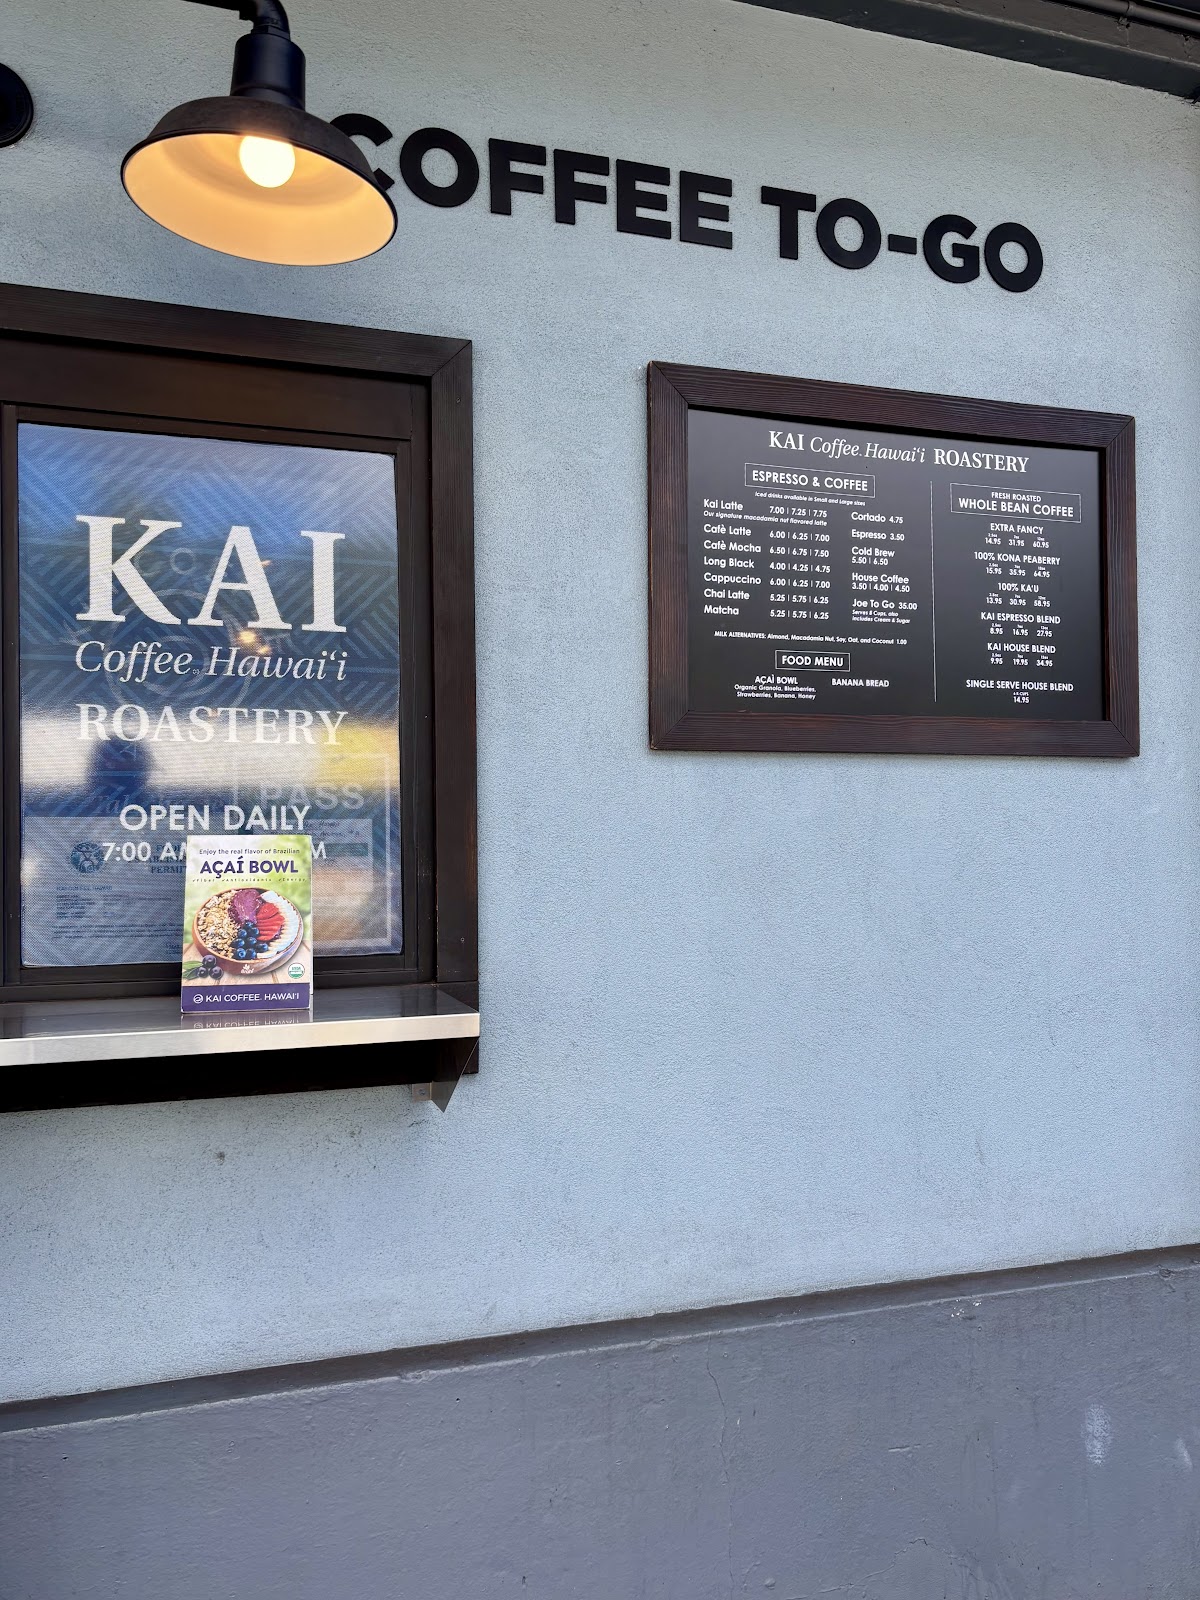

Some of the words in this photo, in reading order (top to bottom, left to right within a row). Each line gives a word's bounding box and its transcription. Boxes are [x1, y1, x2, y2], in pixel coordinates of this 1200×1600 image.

[329, 113, 733, 250] COFFEE
[761, 186, 1043, 293] TO-GO
[769, 430, 805, 450] KAI
[810, 436, 860, 458] Coffee
[934, 448, 1030, 472] ROASTERY
[752, 470, 809, 486] ESPRESSO
[812, 476, 821, 487] &
[824, 477, 868, 492] COFFEE
[991, 492, 1011, 500] FRESH
[1012, 494, 1042, 502] ROASTED
[704, 498, 718, 508] Kai
[720, 500, 744, 511] Latte
[958, 498, 998, 512] WHOLE
[1000, 501, 1030, 514] BEAN
[1033, 504, 1074, 518] COFFEE
[769, 506, 785, 514] 7.00
[792, 508, 806, 516] 7.25
[812, 509, 828, 518] 7.75
[851, 512, 886, 522] Cortado
[888, 516, 904, 524] 4.75
[716, 511, 742, 520] signature
[744, 514, 778, 522] macadamia
[790, 518, 814, 526] flavored
[729, 526, 752, 536] Latte
[990, 522, 1015, 532] EXTRA
[1016, 524, 1044, 534] FANCY
[769, 530, 786, 539] 6.00
[792, 532, 808, 540] 6.25
[814, 534, 830, 542] 7.00
[851, 528, 887, 540] Espresso
[890, 533, 905, 542] 3.50
[728, 541, 762, 553] Mocha
[985, 537, 1002, 545] 14.95
[1008, 539, 1025, 547] 31.95
[1032, 541, 1050, 549] 60.95
[769, 546, 786, 555] 6.50
[792, 548, 808, 556] 6.75
[814, 549, 830, 558] 7.50
[851, 546, 873, 556] Cold
[874, 548, 895, 558] Brew
[704, 556, 727, 568] Long
[728, 558, 755, 568] Black
[852, 556, 867, 564] 5.50
[873, 558, 889, 566] 6.50
[974, 552, 996, 561] 100%
[998, 554, 1022, 563] KONA
[1023, 555, 1061, 566] PEABERRY
[76, 514, 346, 633] KAI
[769, 562, 786, 570] 4.00
[792, 563, 809, 572] 4.25
[814, 565, 831, 574] 4.75
[986, 567, 1002, 575] 15.95
[1009, 568, 1026, 576] 35.95
[1034, 570, 1050, 578] 64.95
[704, 572, 762, 584] Cappuccino
[769, 578, 786, 586] 6.00
[792, 579, 809, 588] 6.25
[815, 580, 831, 589] 7.00
[852, 572, 879, 582] House
[880, 574, 910, 584] Coffee
[852, 582, 868, 590] 3.50
[873, 583, 889, 592] 4.00
[894, 585, 910, 593] 4.50
[998, 582, 1019, 592] 100%
[704, 588, 726, 598] Chai
[728, 590, 750, 600] Latte
[769, 594, 786, 602] 5.25
[792, 594, 808, 604] 5.75
[813, 596, 829, 604] 6.25
[852, 598, 868, 608] Joe
[870, 599, 880, 608] To
[882, 600, 896, 609] Go
[898, 602, 918, 610] 35.00
[986, 596, 1002, 605] 13.95
[1009, 598, 1026, 606] 30.95
[704, 604, 740, 615] Matcha
[769, 609, 786, 618] 5.25
[792, 610, 808, 620] 5.75
[813, 612, 830, 620] 6.25
[980, 612, 995, 621] KAI
[997, 612, 1035, 623] ESPRESSO
[1036, 614, 1061, 624] BLEND
[714, 630, 728, 638] MILK
[728, 631, 767, 640] ALTERNATIVES:
[790, 634, 824, 642] Macadamia
[1012, 628, 1029, 636] 16.95
[1036, 630, 1053, 638] 27.95
[987, 642, 1002, 651] KAI
[1003, 644, 1030, 653] HOUSE
[1032, 644, 1056, 654] BLEND
[76, 640, 193, 682] Coffee
[782, 654, 812, 666] FOOD
[814, 656, 844, 667] MENU
[1012, 658, 1029, 666] 19.95
[776, 676, 799, 684] BOWL
[831, 678, 864, 687] BANANA
[866, 679, 890, 688] BREAD
[966, 679, 995, 690] SINGLE
[996, 680, 1020, 690] SERVE
[1022, 682, 1048, 691] HOUSE
[1050, 682, 1074, 692] BLEND
[734, 684, 758, 692] Organic
[1013, 696, 1030, 704] 14.95
[76, 704, 348, 746] ROASTERY
[259, 783, 366, 810] PASS
[119, 804, 210, 831] OPEN
[224, 804, 311, 831] DAILY
[102, 842, 151, 862] 7:00
[311, 840, 327, 860] M
[199, 848, 217, 856] Enjoy
[200, 856, 244, 878] AÇAÍ
[249, 860, 299, 874] BOWL
[205, 994, 222, 1002] KAI
[224, 994, 260, 1002] COFFEE
